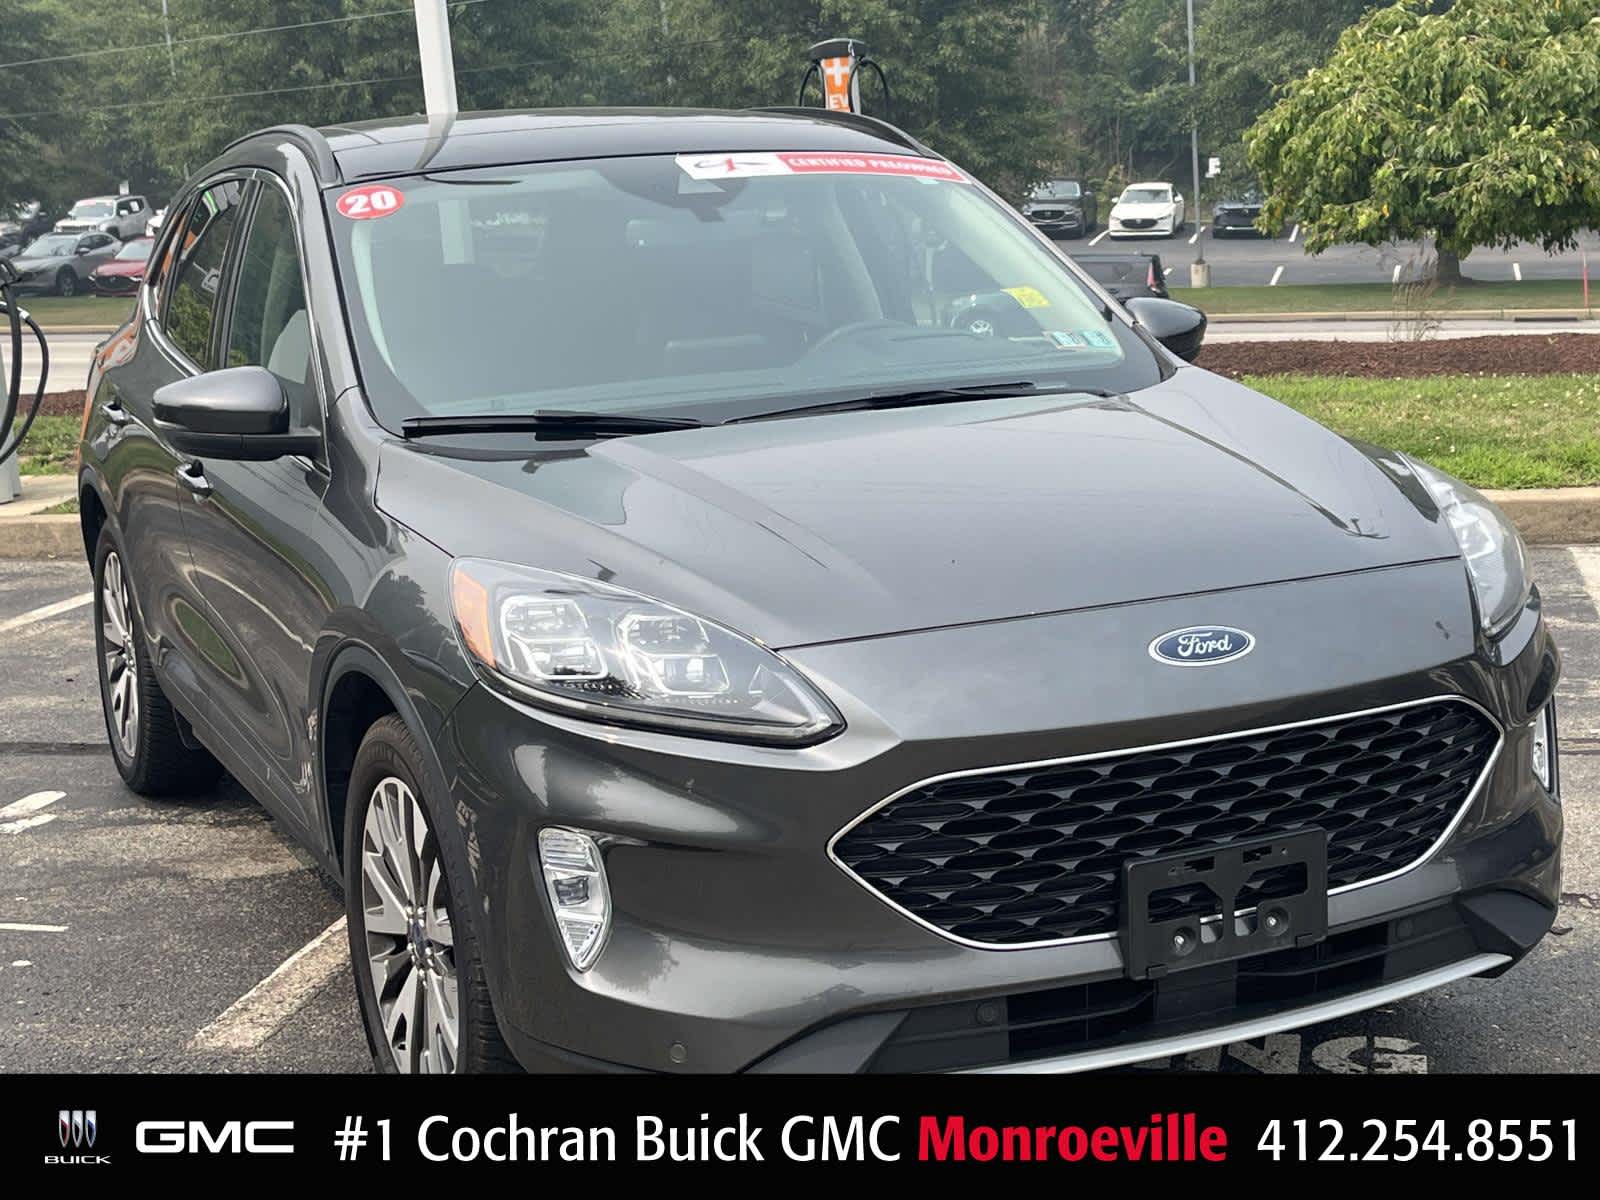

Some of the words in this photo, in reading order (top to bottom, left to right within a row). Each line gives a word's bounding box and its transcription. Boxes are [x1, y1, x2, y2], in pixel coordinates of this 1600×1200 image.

[788, 158, 866, 168] CERTIFIED
[344, 191, 398, 214] 20
[1177, 631, 1232, 657] Ford
